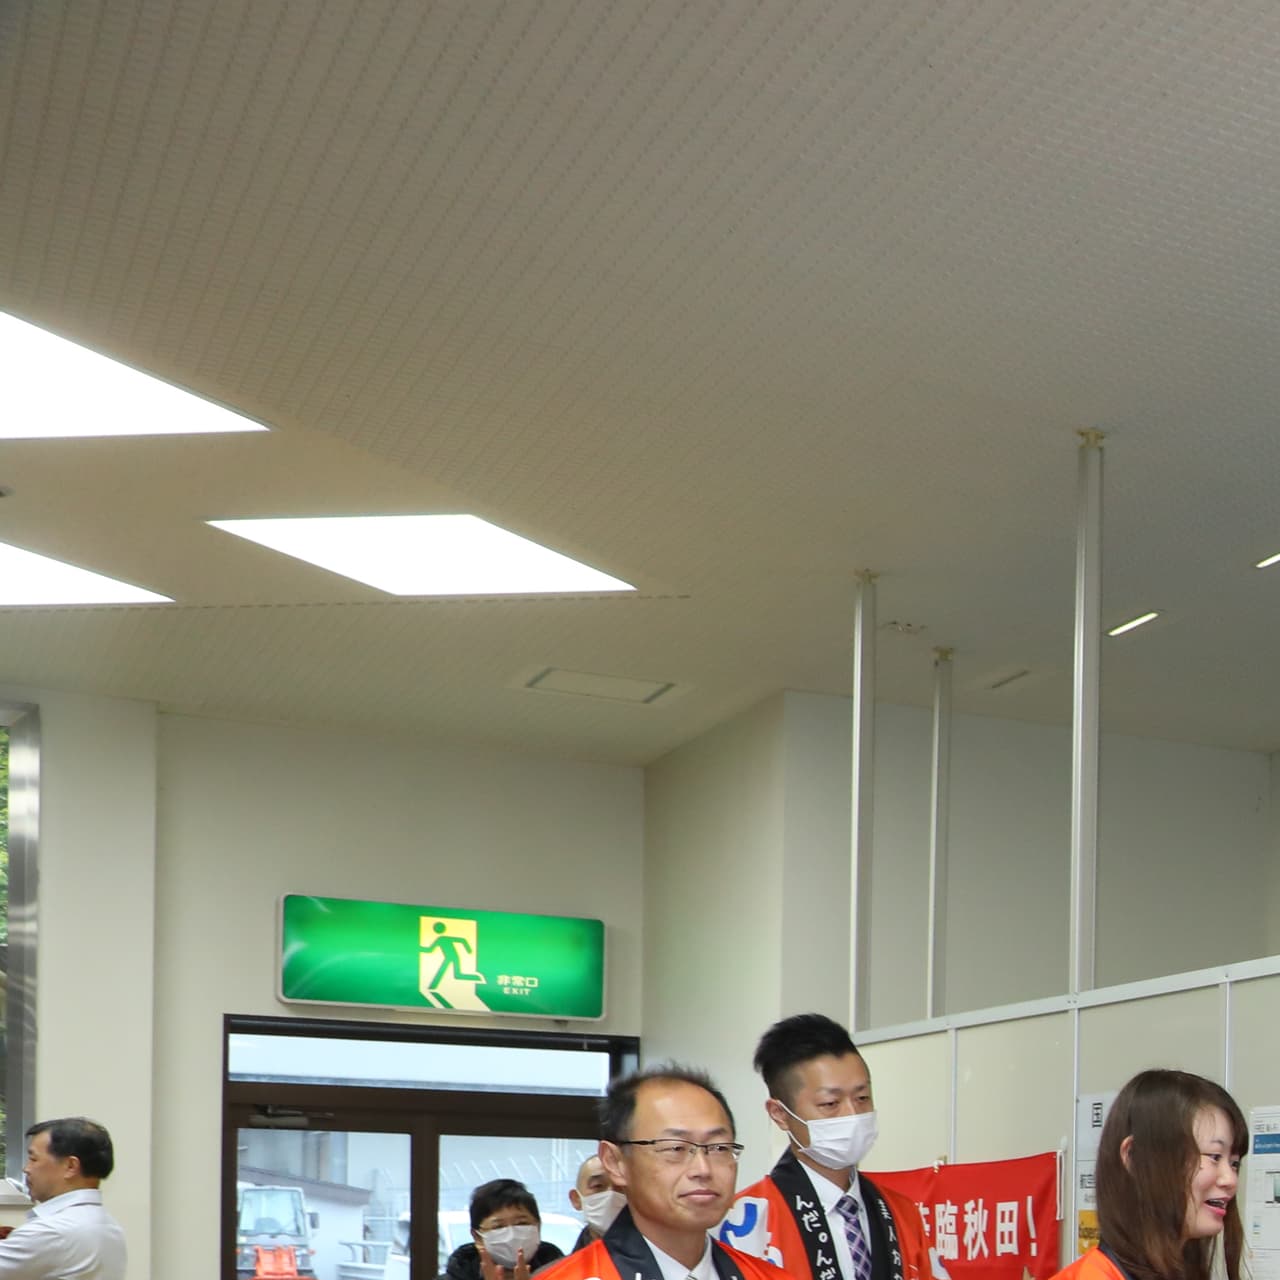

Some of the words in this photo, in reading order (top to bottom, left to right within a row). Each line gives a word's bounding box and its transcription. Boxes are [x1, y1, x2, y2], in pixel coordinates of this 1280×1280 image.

[496, 975, 539, 987] 非常口
[503, 987, 531, 995] EXIT
